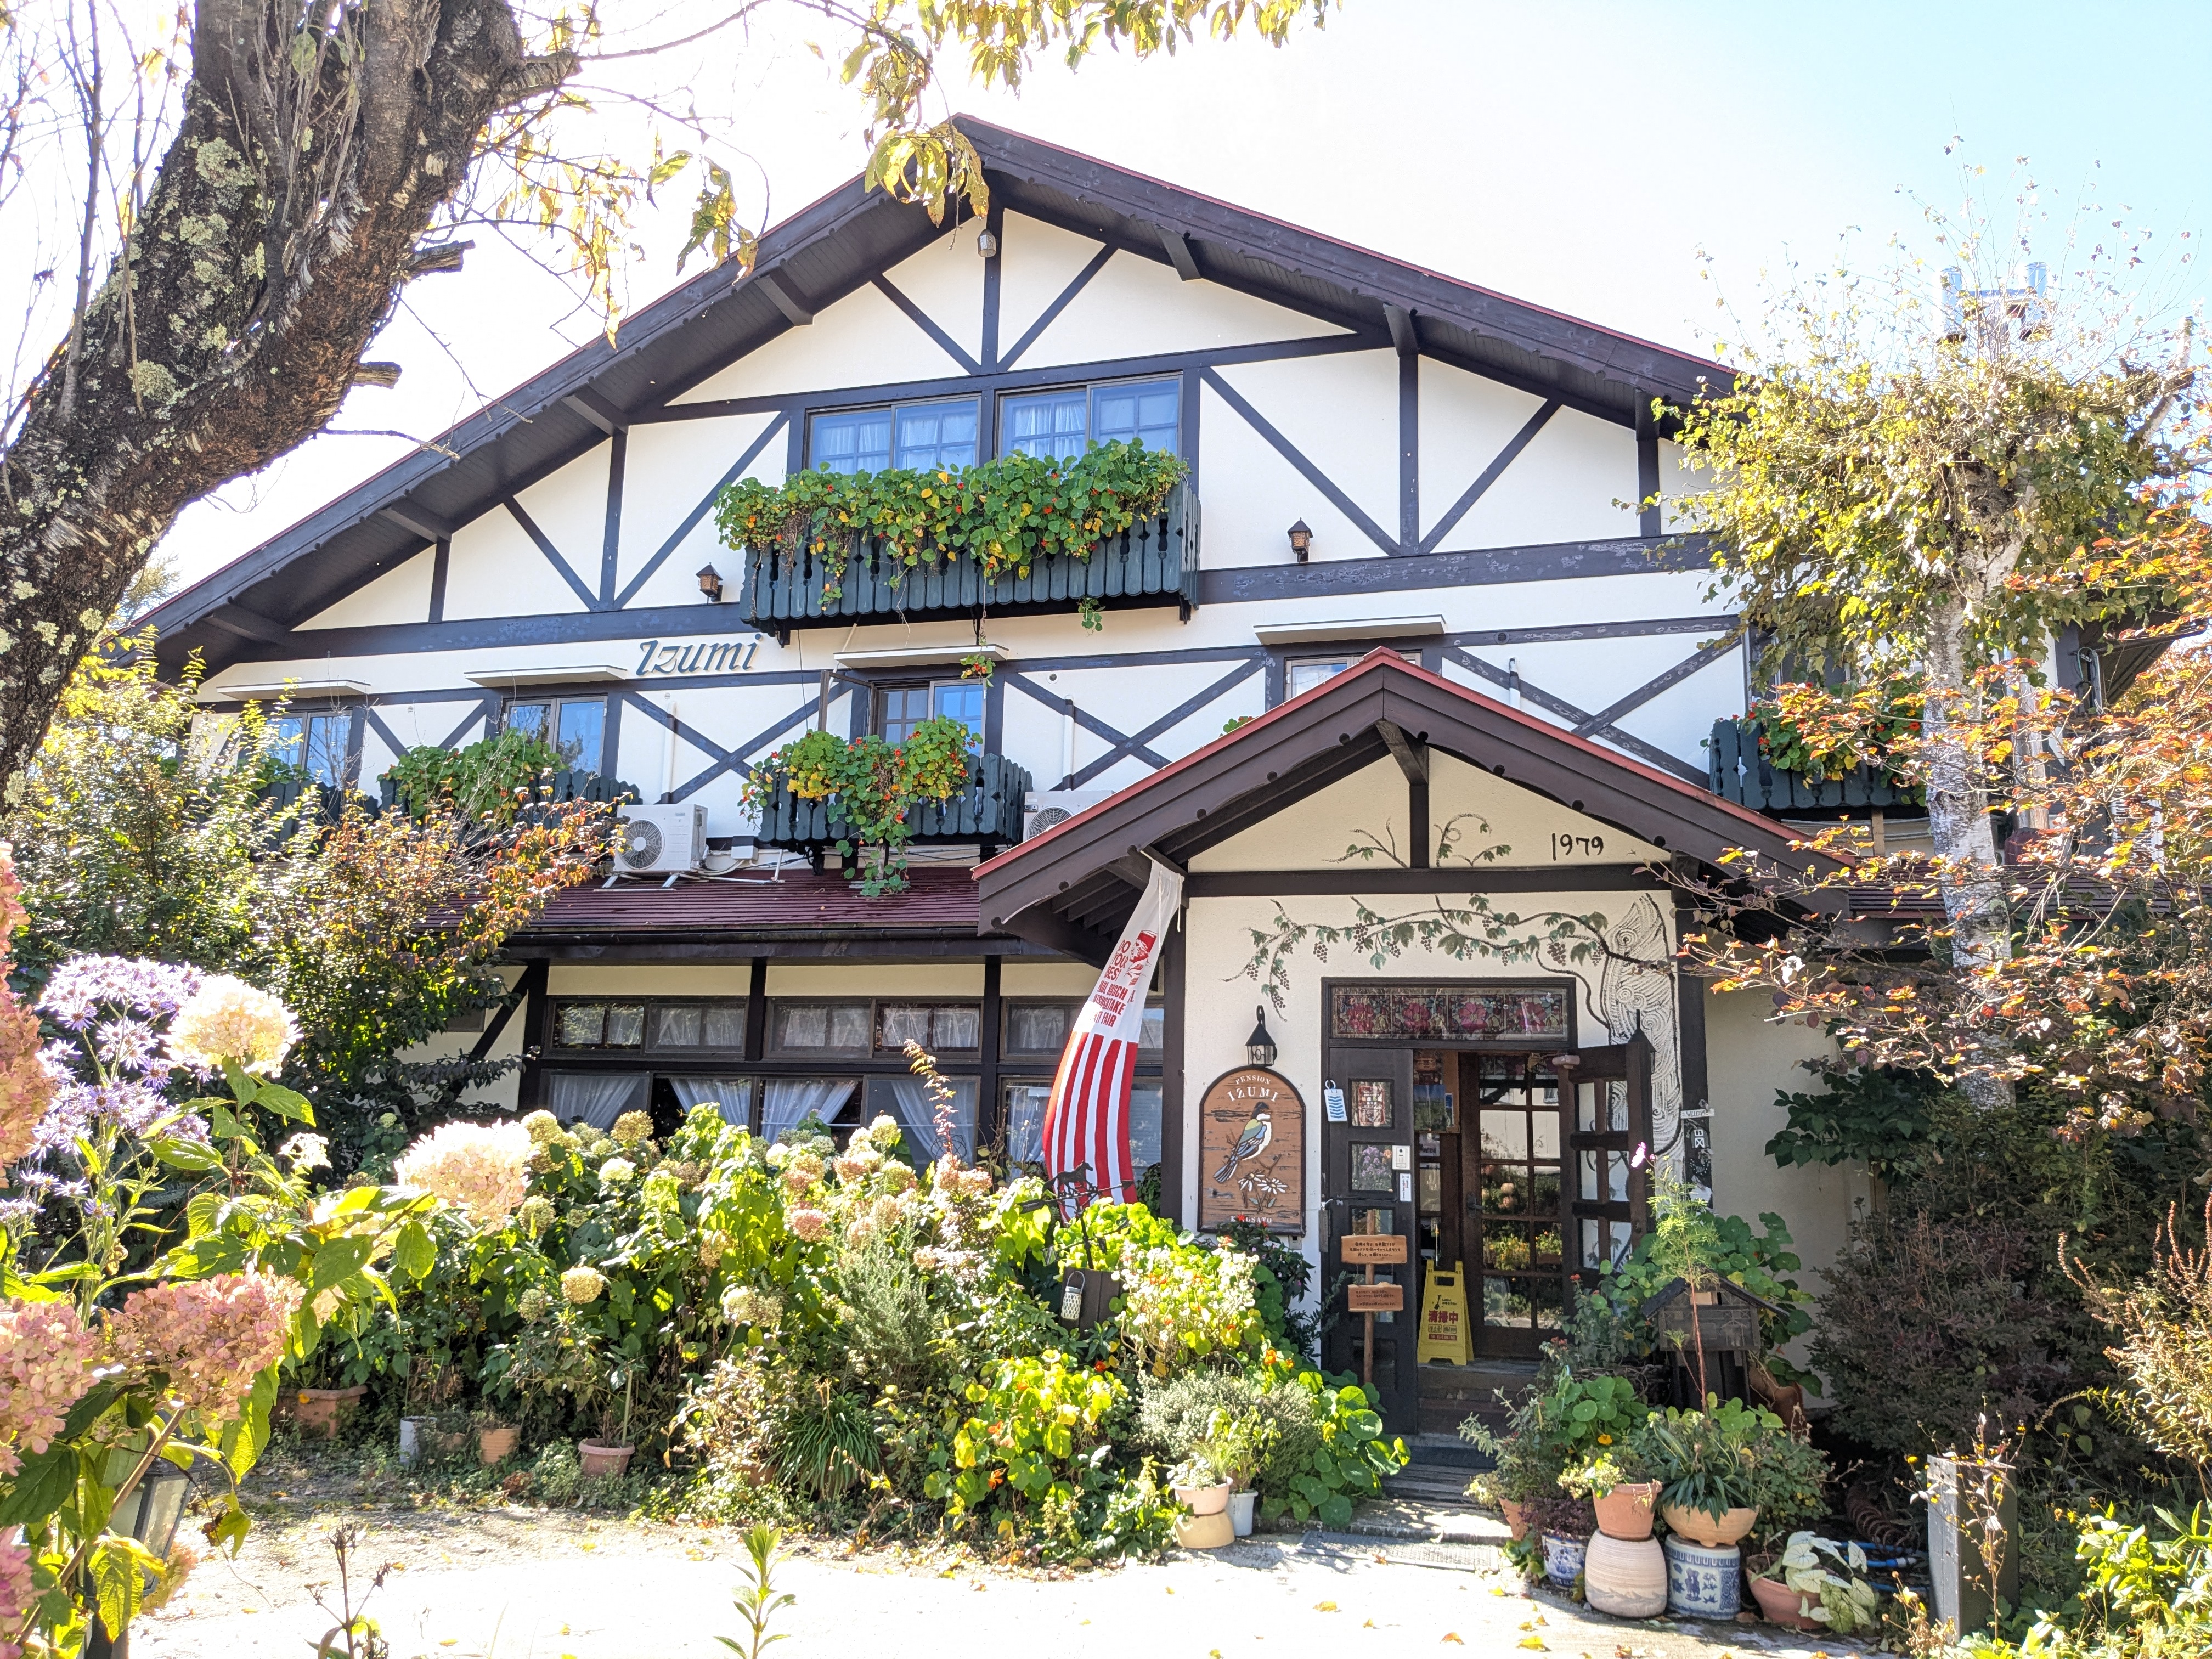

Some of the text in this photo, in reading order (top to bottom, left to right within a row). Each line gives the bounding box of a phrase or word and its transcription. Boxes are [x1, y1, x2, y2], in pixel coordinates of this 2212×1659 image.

[636, 633, 763, 676] Izumi
[1551, 833, 1604, 861] 1979
[1101, 1012, 1118, 1028] FAIR
[1235, 1075, 1271, 1085] PENSION
[1227, 1086, 1278, 1102] IZUMI
